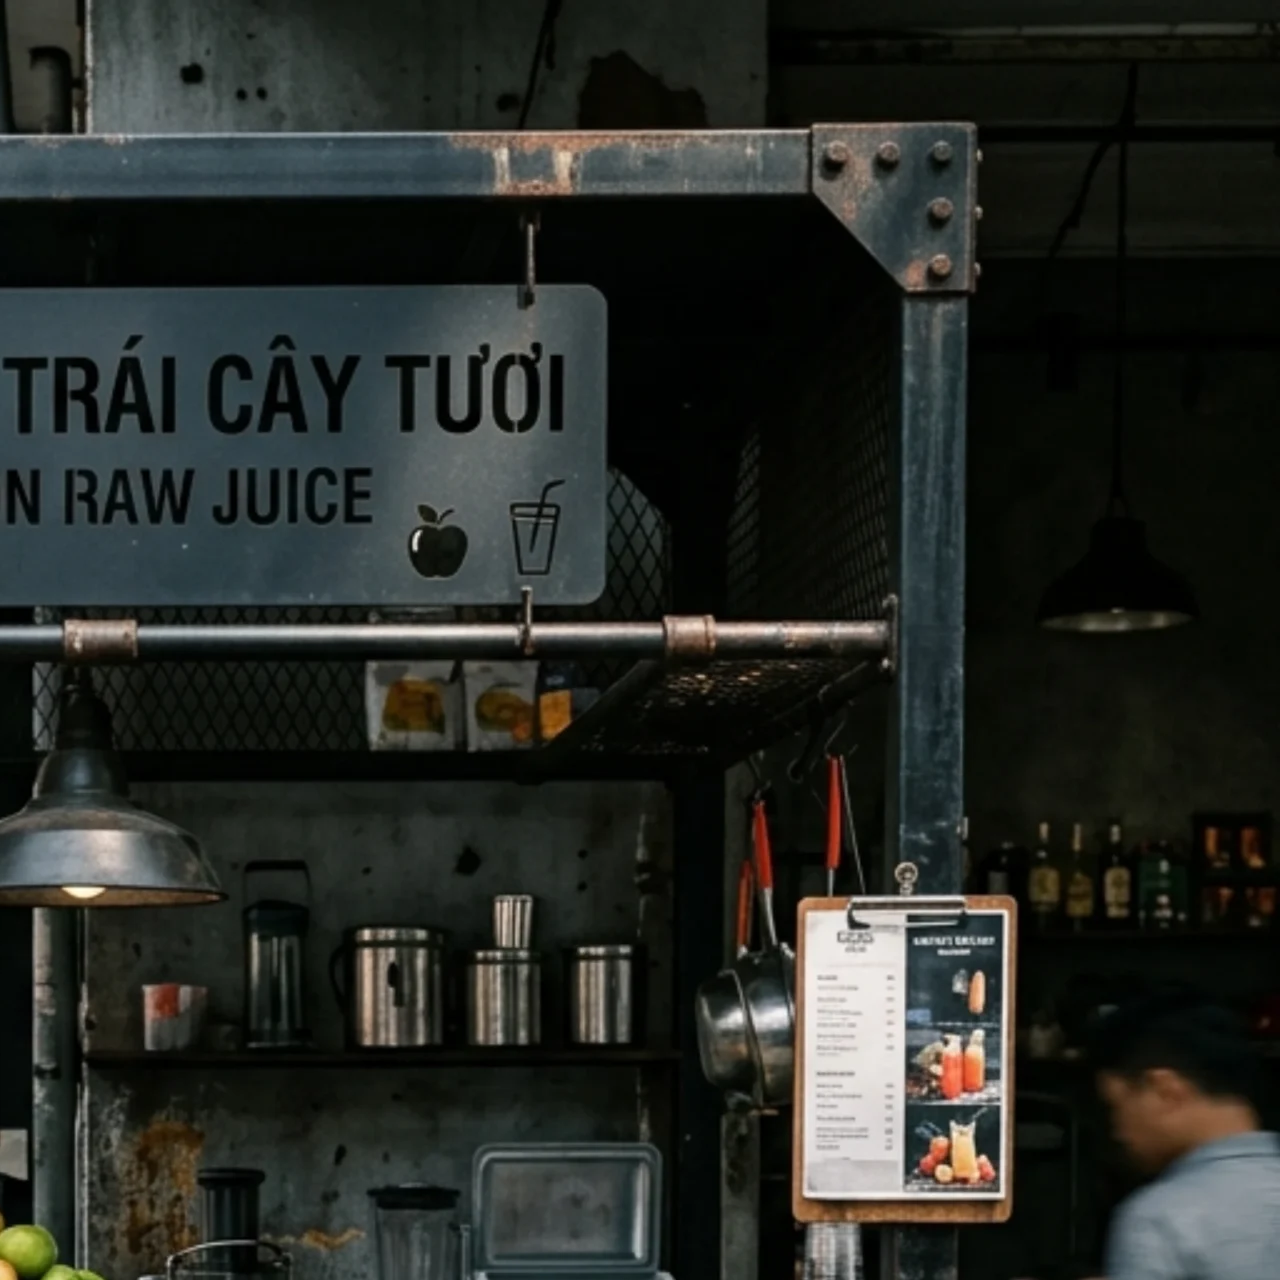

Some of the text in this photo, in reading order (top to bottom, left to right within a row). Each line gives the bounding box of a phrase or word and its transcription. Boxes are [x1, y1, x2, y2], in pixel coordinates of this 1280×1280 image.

[2, 334, 177, 435] TRÁI
[206, 334, 361, 435] CÂY
[384, 341, 565, 435] TƯƠI
[64, 468, 195, 525] RAW
[211, 467, 374, 526] JUICE
